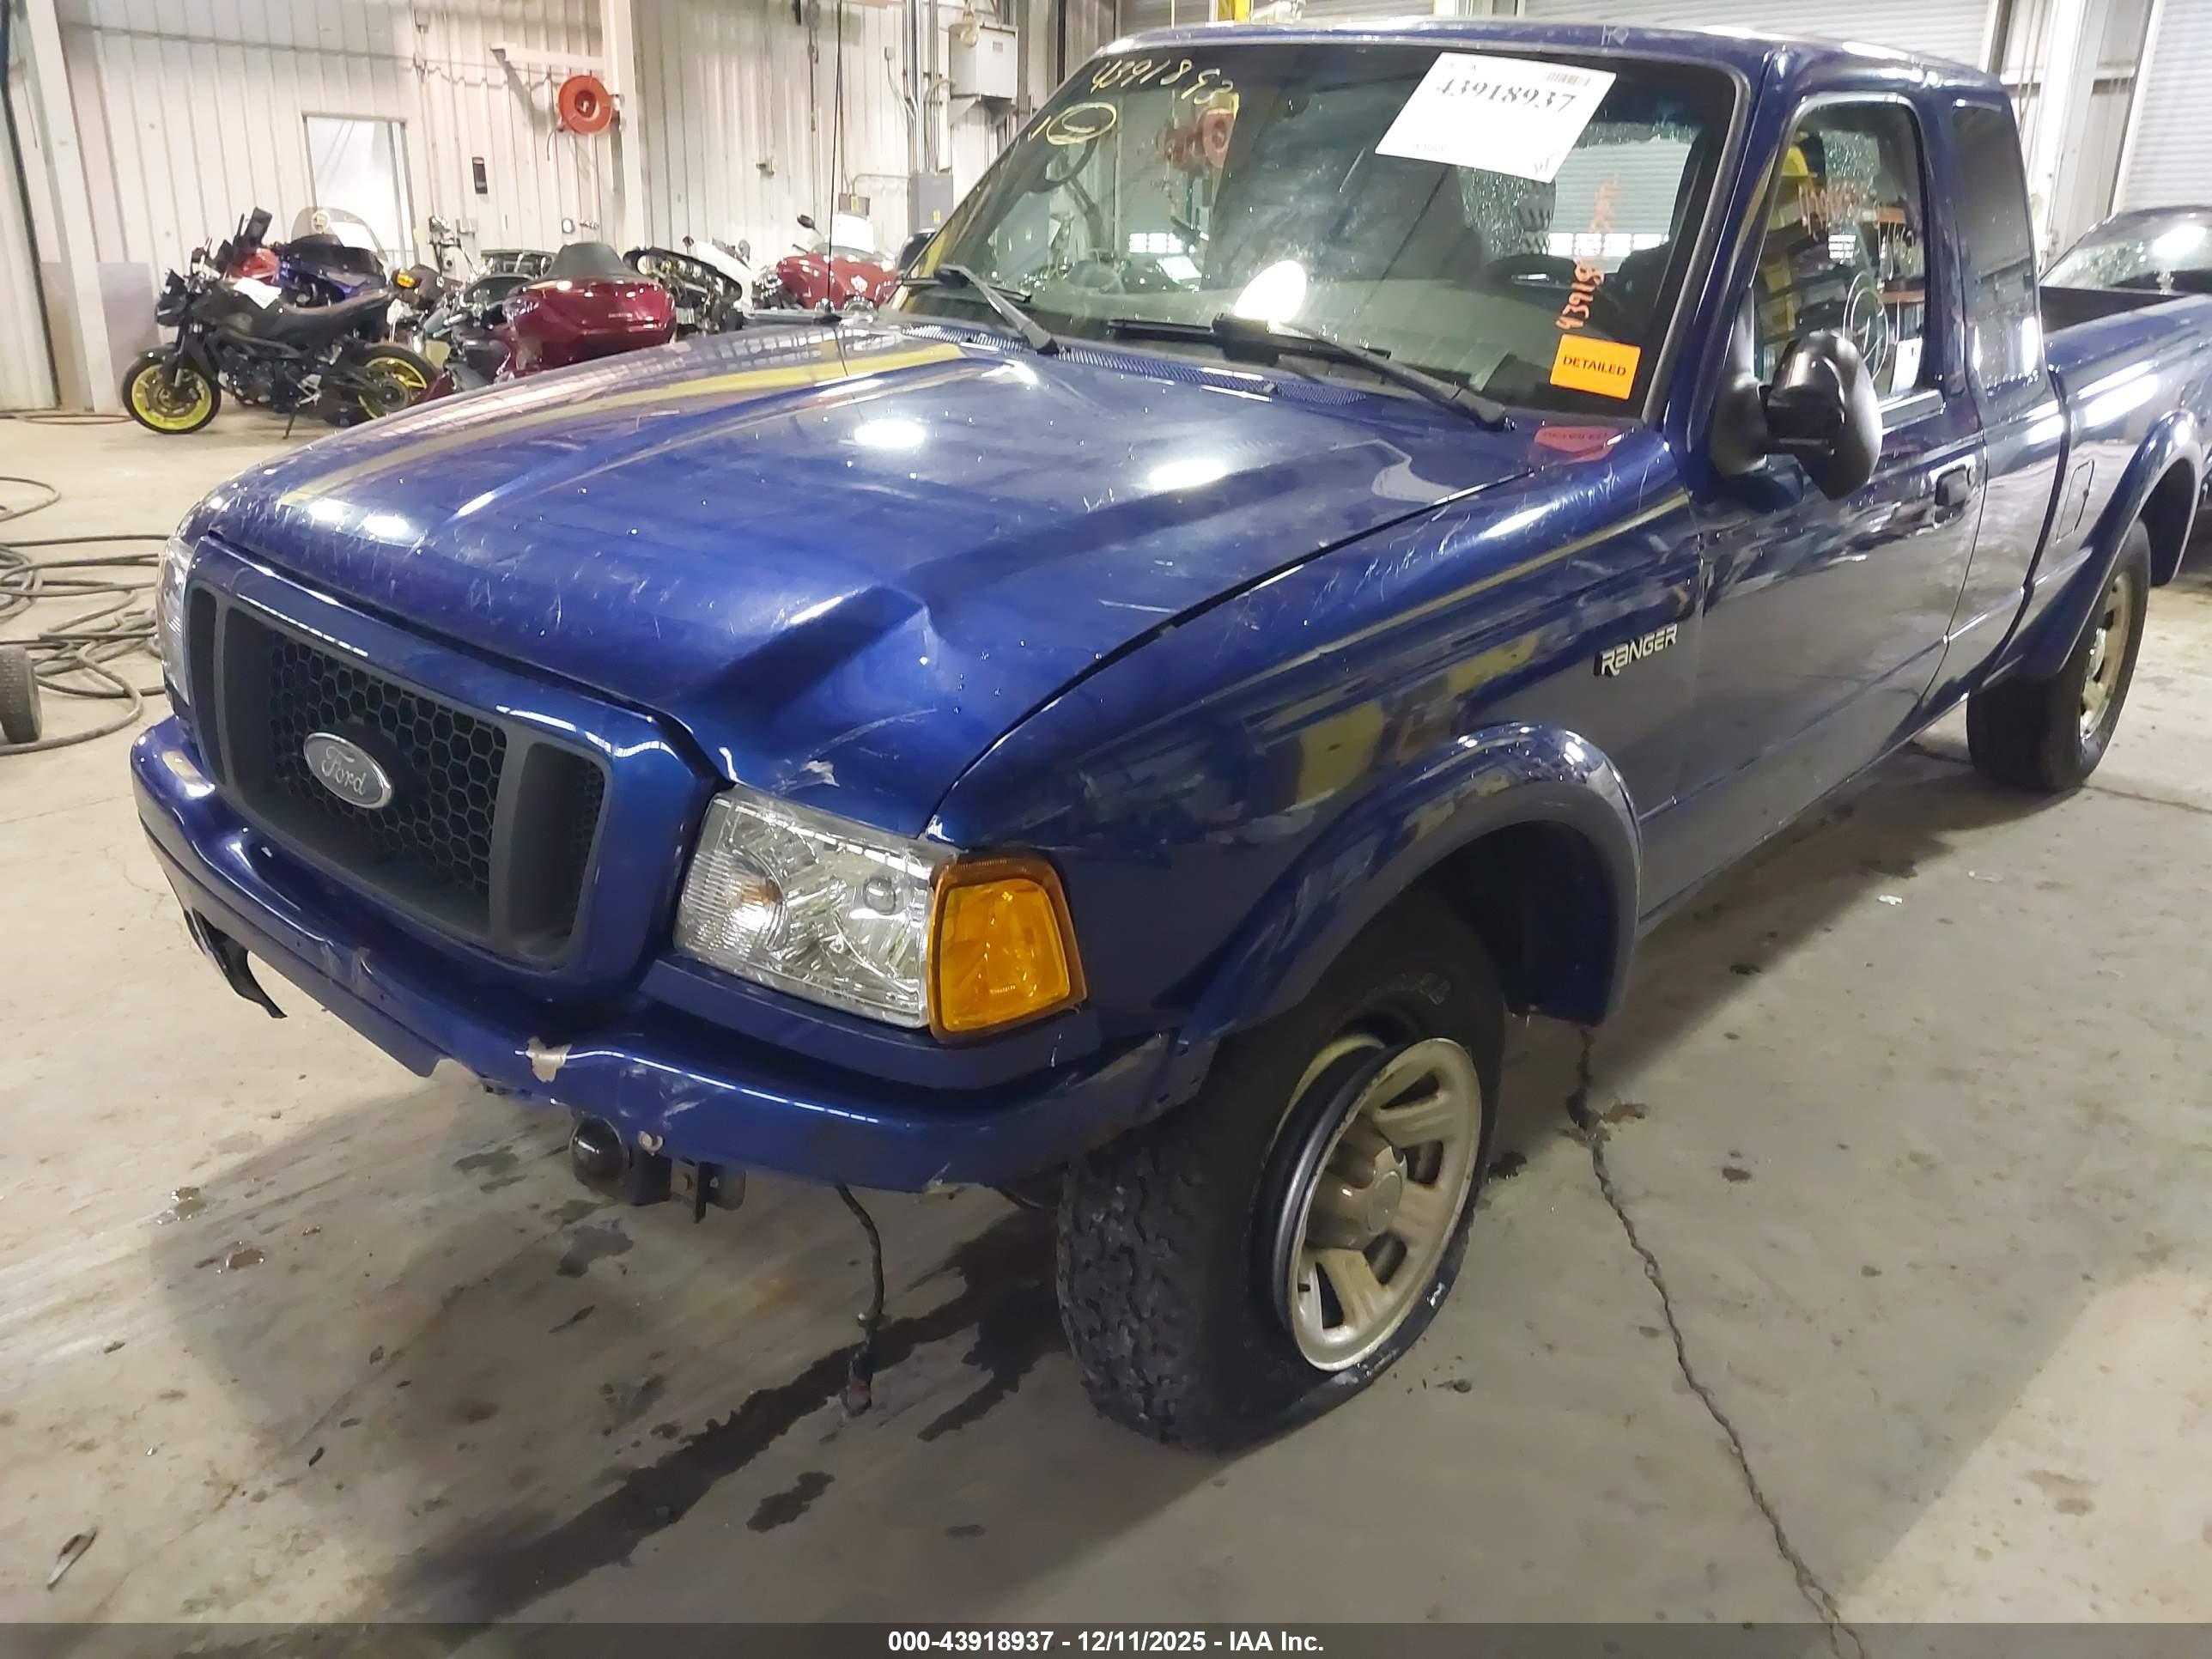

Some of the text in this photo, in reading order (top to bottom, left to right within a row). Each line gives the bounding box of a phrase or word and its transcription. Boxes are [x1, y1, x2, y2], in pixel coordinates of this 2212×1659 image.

[1437, 78, 1578, 113] 43918937
[1562, 355, 1627, 378] DETAILED
[1600, 623, 1679, 677] RANGER
[321, 744, 368, 797] Ford
